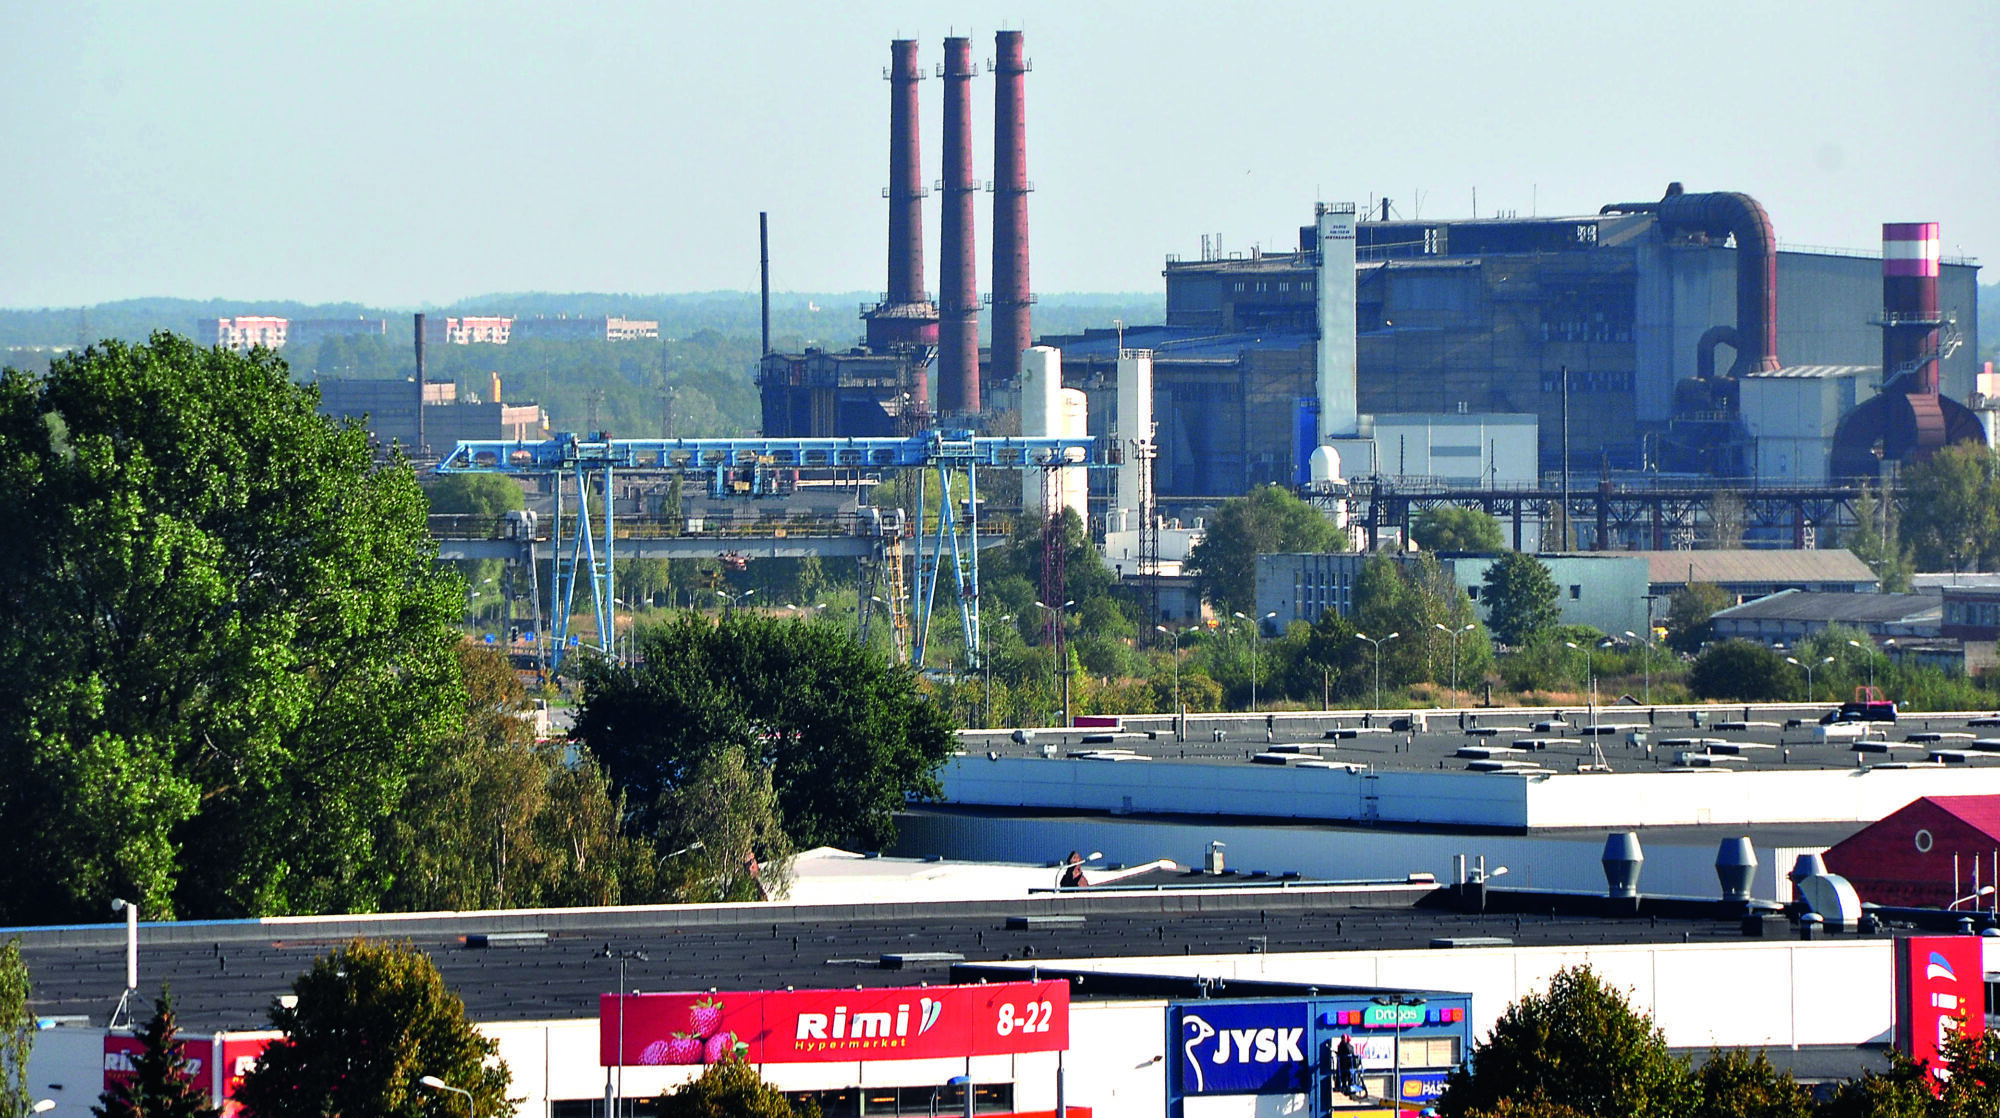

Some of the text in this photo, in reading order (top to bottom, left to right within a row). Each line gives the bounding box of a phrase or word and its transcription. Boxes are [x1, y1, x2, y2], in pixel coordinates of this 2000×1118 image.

[796, 1004, 910, 1040] Rimi
[997, 1001, 1053, 1036] 8-22
[1375, 1009, 1417, 1022] Drogas
[795, 1038, 906, 1051] Hypermarket
[1213, 1027, 1304, 1064] JYSK
